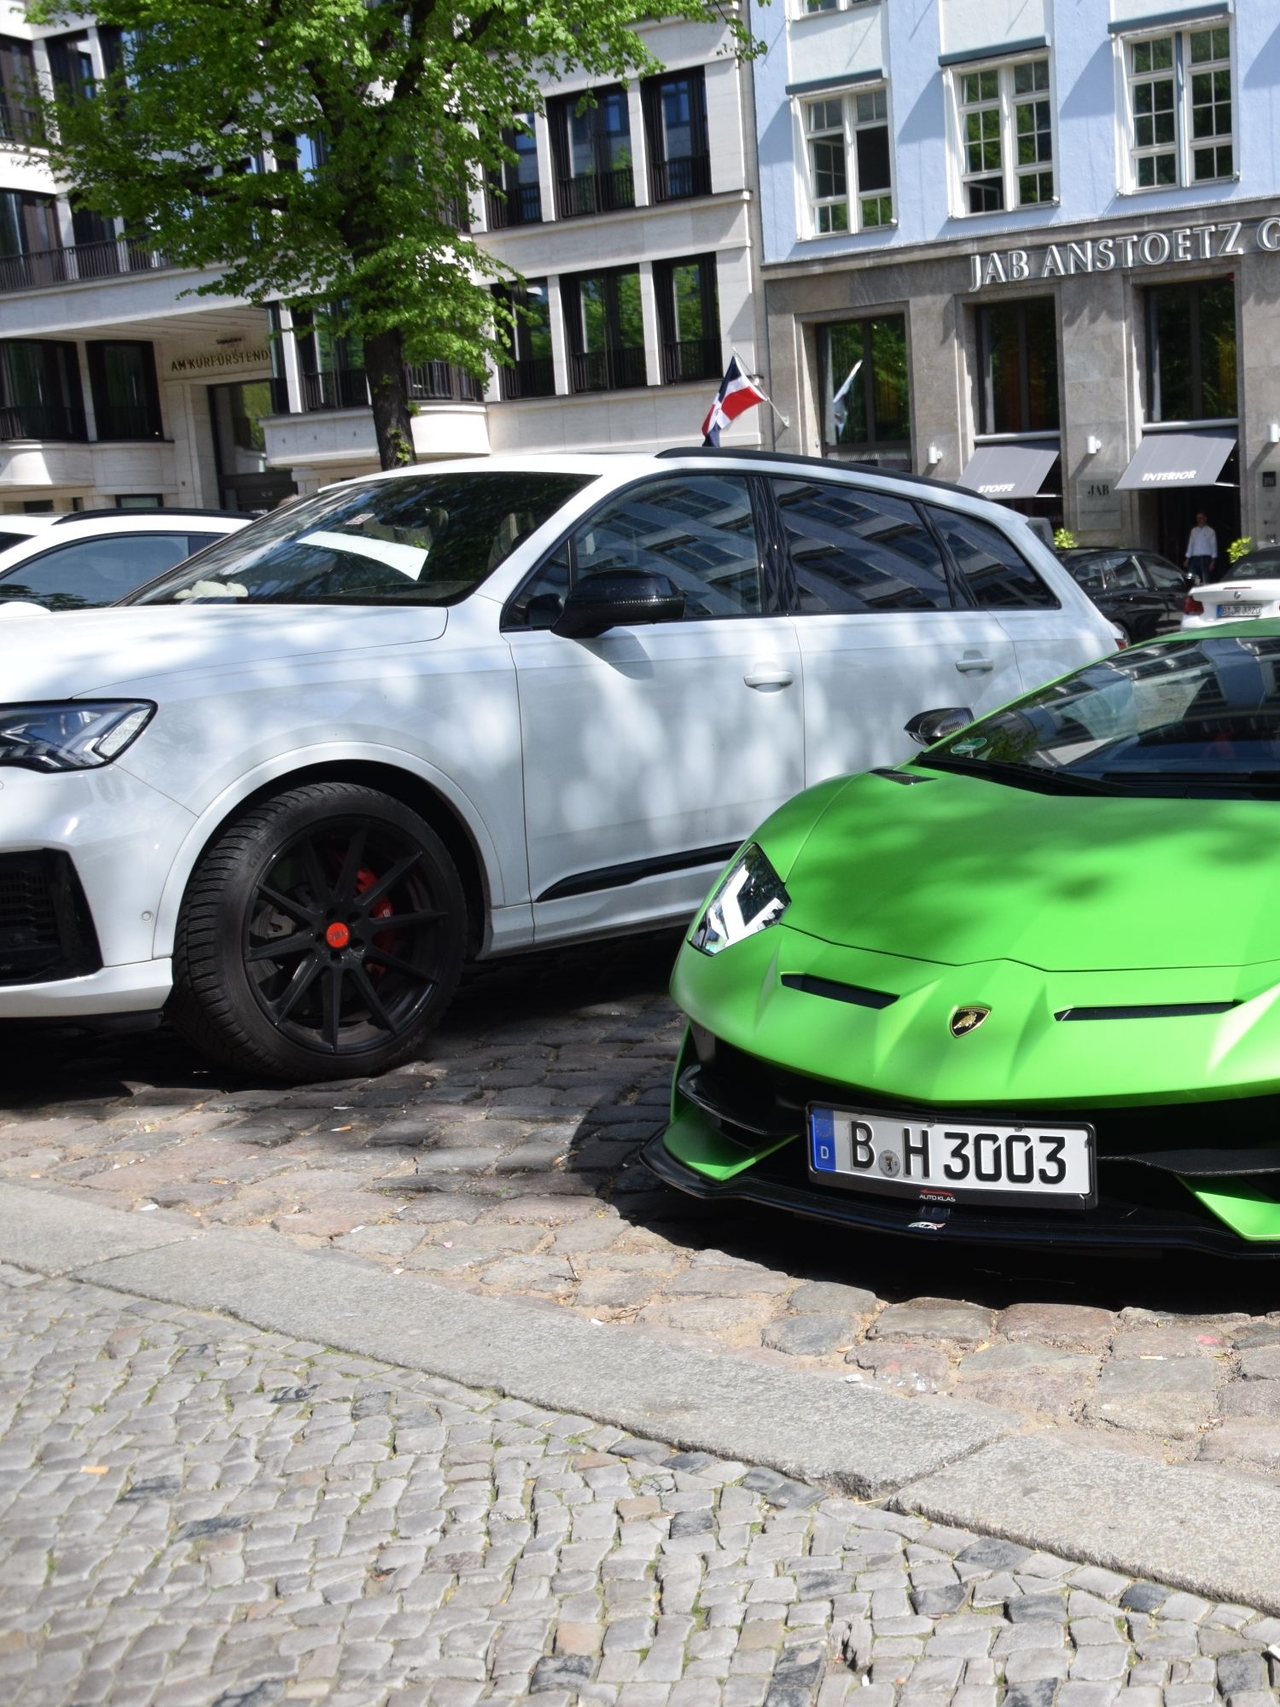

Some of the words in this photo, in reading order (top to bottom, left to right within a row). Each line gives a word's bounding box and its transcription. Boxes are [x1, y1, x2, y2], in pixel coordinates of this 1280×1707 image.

[969, 249, 1030, 293] JAB
[1041, 221, 1244, 278] ANSTOETZ
[188, 348, 271, 370] KURFÜRSTEND
[1141, 469, 1197, 482] INTERIOR
[977, 482, 1016, 494] STOFFE
[1087, 484, 1110, 497] JAB
[820, 1145, 830, 1159] D
[850, 1120, 876, 1169] B
[902, 1126, 931, 1179] H
[943, 1131, 1067, 1185] 3003
